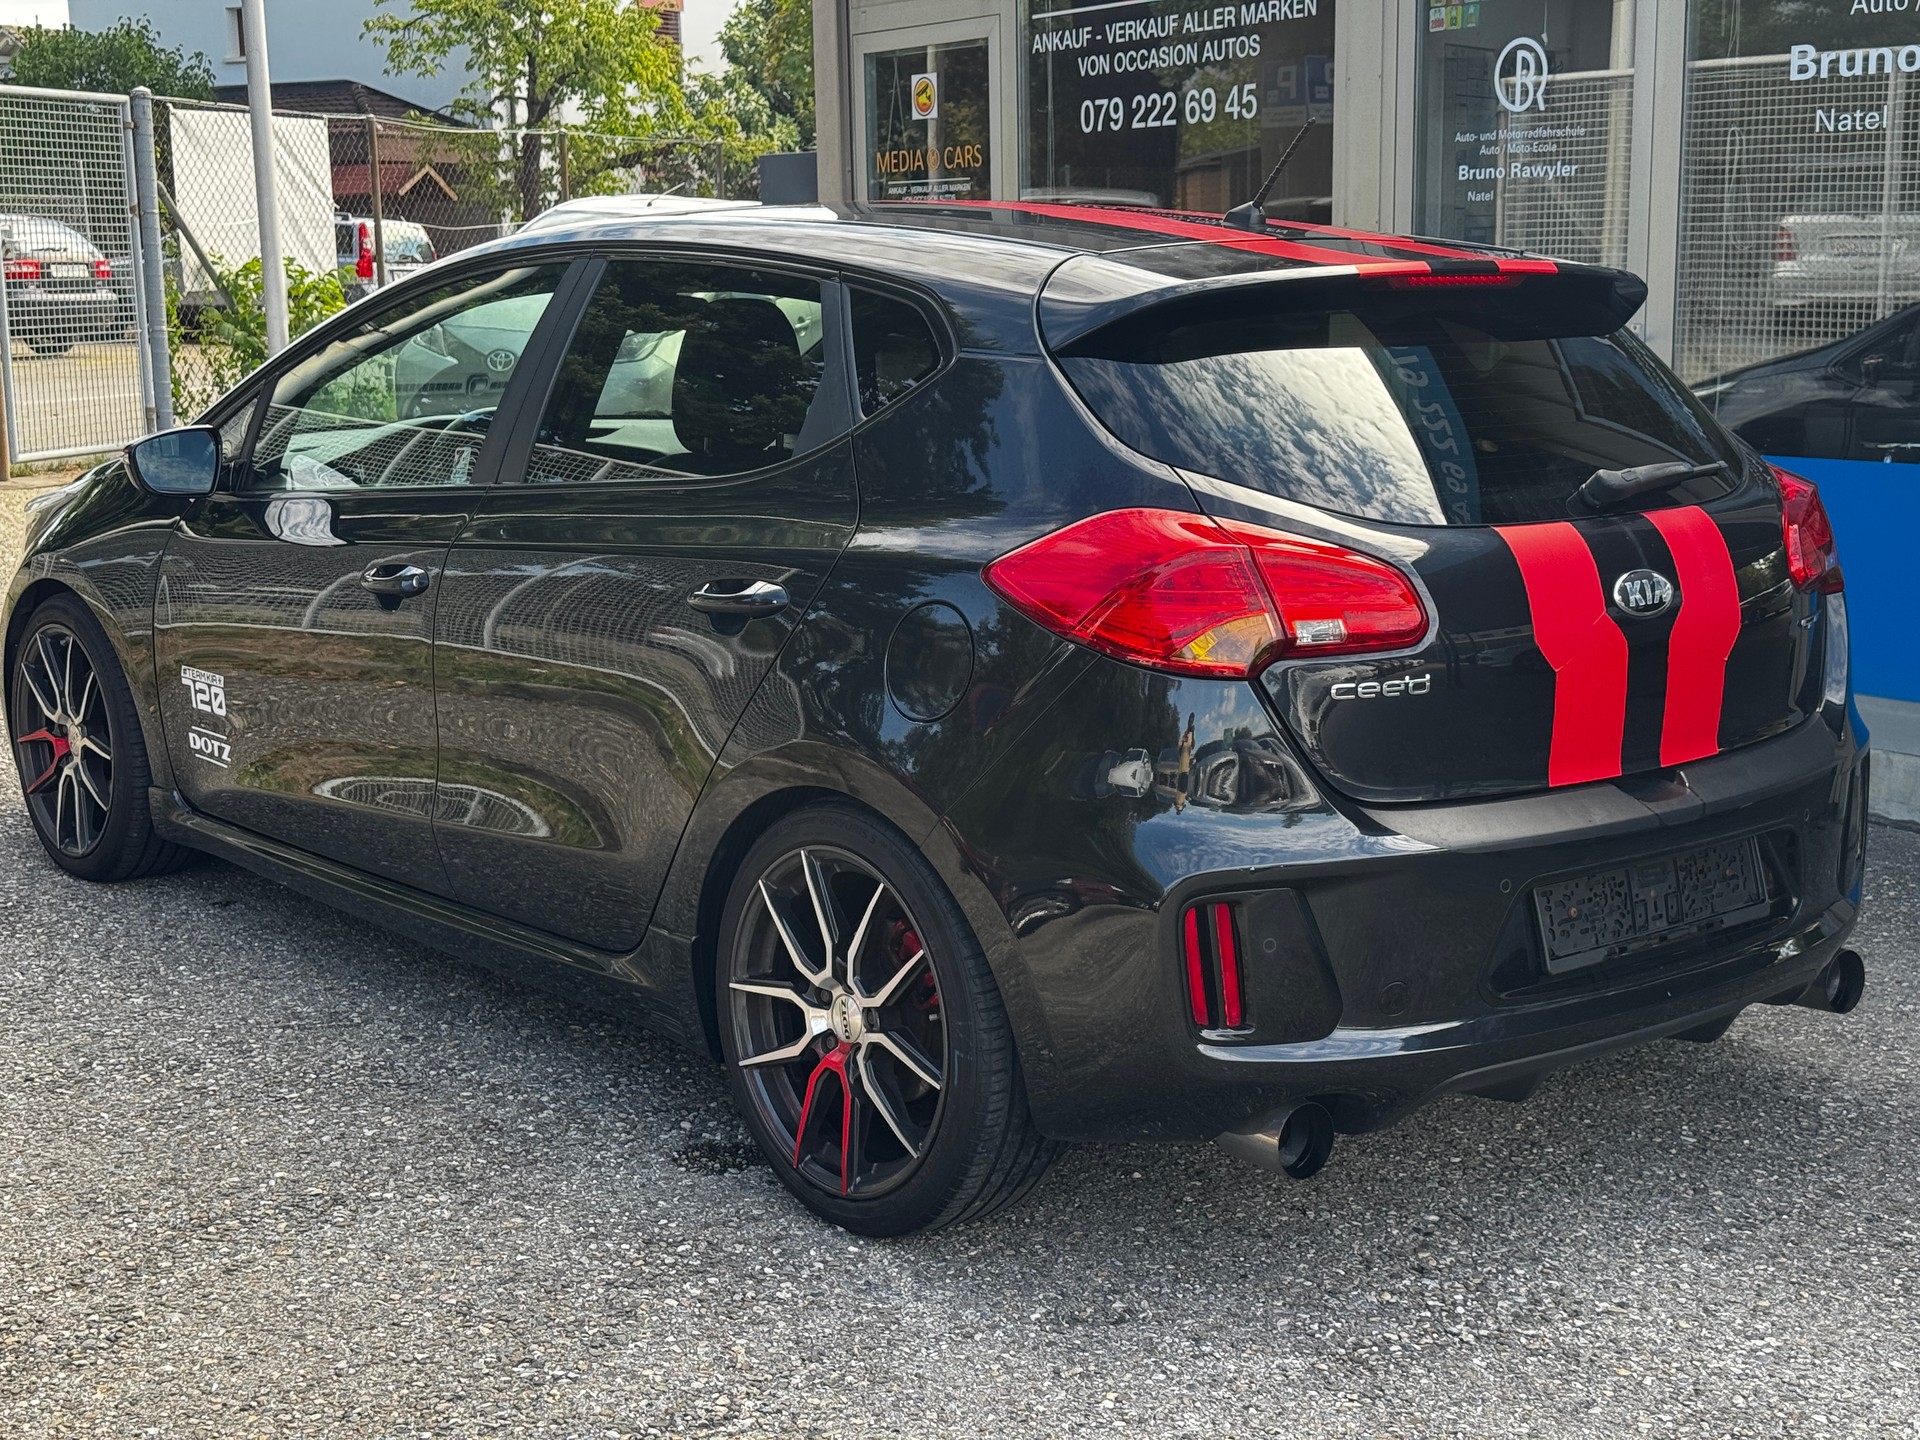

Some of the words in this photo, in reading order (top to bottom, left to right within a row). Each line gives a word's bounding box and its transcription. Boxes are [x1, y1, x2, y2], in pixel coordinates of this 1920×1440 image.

[1032, 26, 1093, 54] ANKAUF
[1105, 14, 1179, 44] VERKAUF
[1182, 7, 1236, 35] ALLER
[1241, 0, 1318, 26] MARKEN
[1078, 53, 1110, 77] VON
[1114, 41, 1198, 73] OCCASION
[1201, 34, 1261, 63] AUTOS
[1789, 44, 1920, 82] Bruno
[1080, 96, 1125, 134] 079
[1131, 91, 1178, 129] 222
[1184, 87, 1217, 125] 69
[1224, 82, 1258, 120] 45
[1815, 104, 1888, 133] Natel
[1454, 131, 1478, 143] Auto-
[1479, 131, 1496, 141] und
[1498, 126, 1586, 141] Motorradfahrschule
[1479, 144, 1500, 156] Auto
[1508, 142, 1557, 154] Moto-Ecole
[876, 149, 924, 174] MEDIA
[943, 144, 983, 170] CARS
[1458, 165, 1506, 181] Bruno
[1511, 161, 1578, 181] Rawyler
[1467, 190, 1494, 202] Natel
[1624, 577, 1673, 608] KIA
[181, 677, 227, 717] 720
[188, 731, 232, 762] DOTZ
